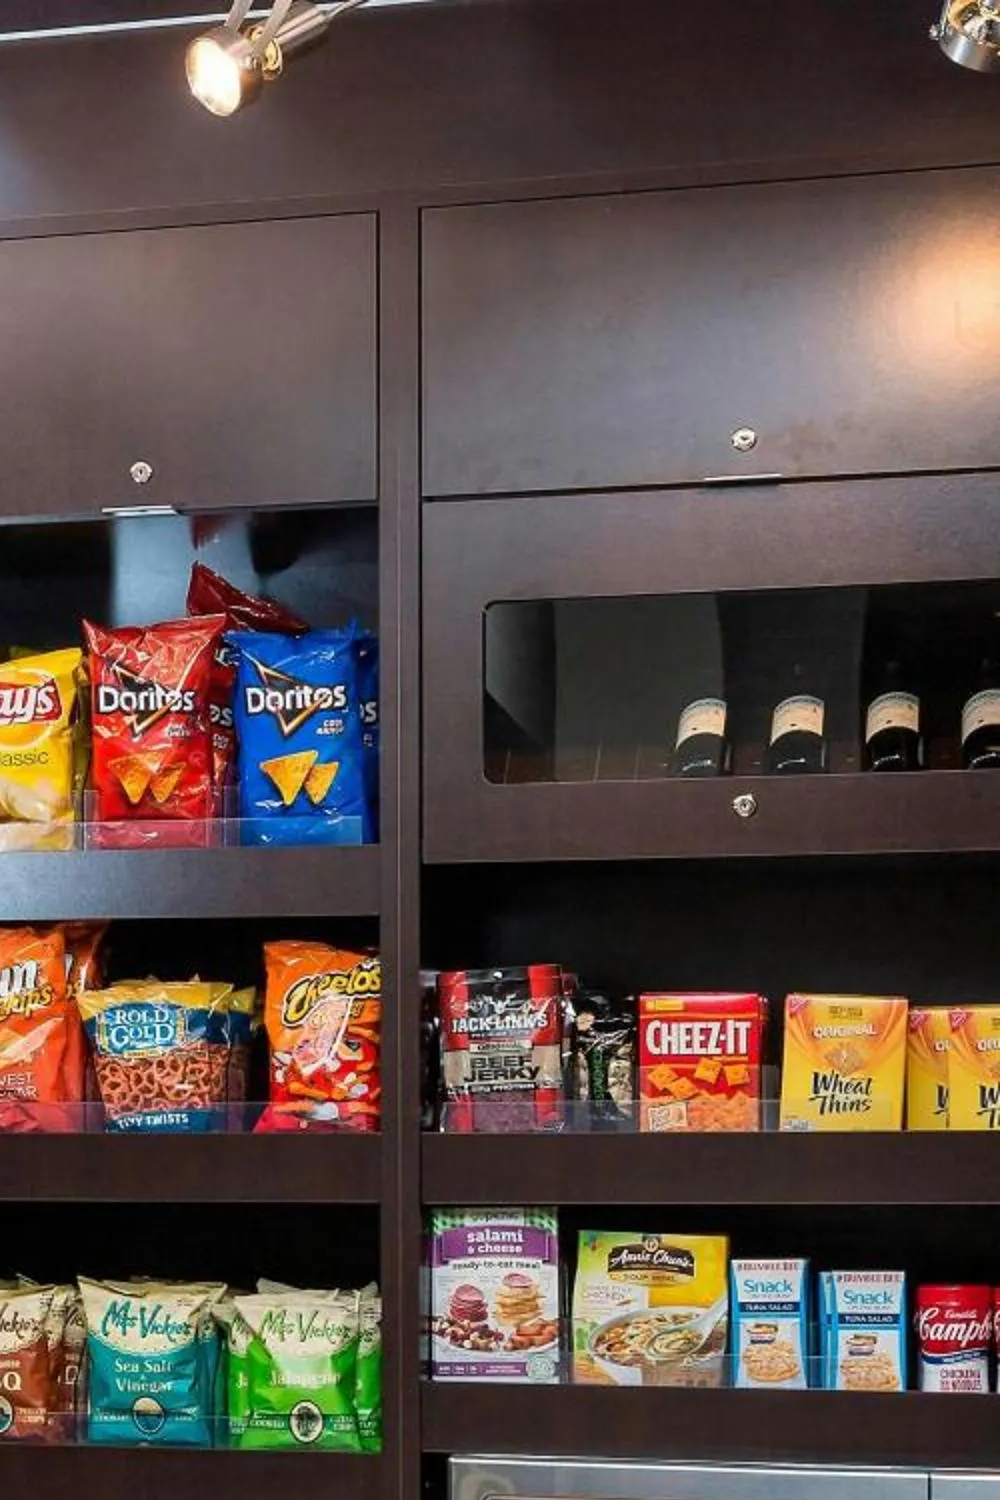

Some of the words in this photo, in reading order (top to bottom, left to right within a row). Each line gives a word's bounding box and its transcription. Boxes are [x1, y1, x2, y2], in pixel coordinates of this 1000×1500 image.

[99, 684, 195, 713] Doritos
[246, 685, 347, 714] Doritos
[115, 1008, 169, 1025] ROLD
[110, 1023, 174, 1047] GOLD
[646, 1020, 751, 1055] CHEEZ-IT
[469, 1055, 532, 1068] BEEF
[463, 1066, 541, 1082] JERKY
[812, 1070, 873, 1096] Wheat
[808, 1094, 873, 1116] Thins
[467, 1228, 525, 1243] salami
[477, 1244, 523, 1254] cheese
[743, 1279, 793, 1293] Snack
[843, 1289, 894, 1304] Snack
[115, 1359, 140, 1373] Sea
[144, 1359, 172, 1373] Salt
[115, 1378, 173, 1394] Vinegar
